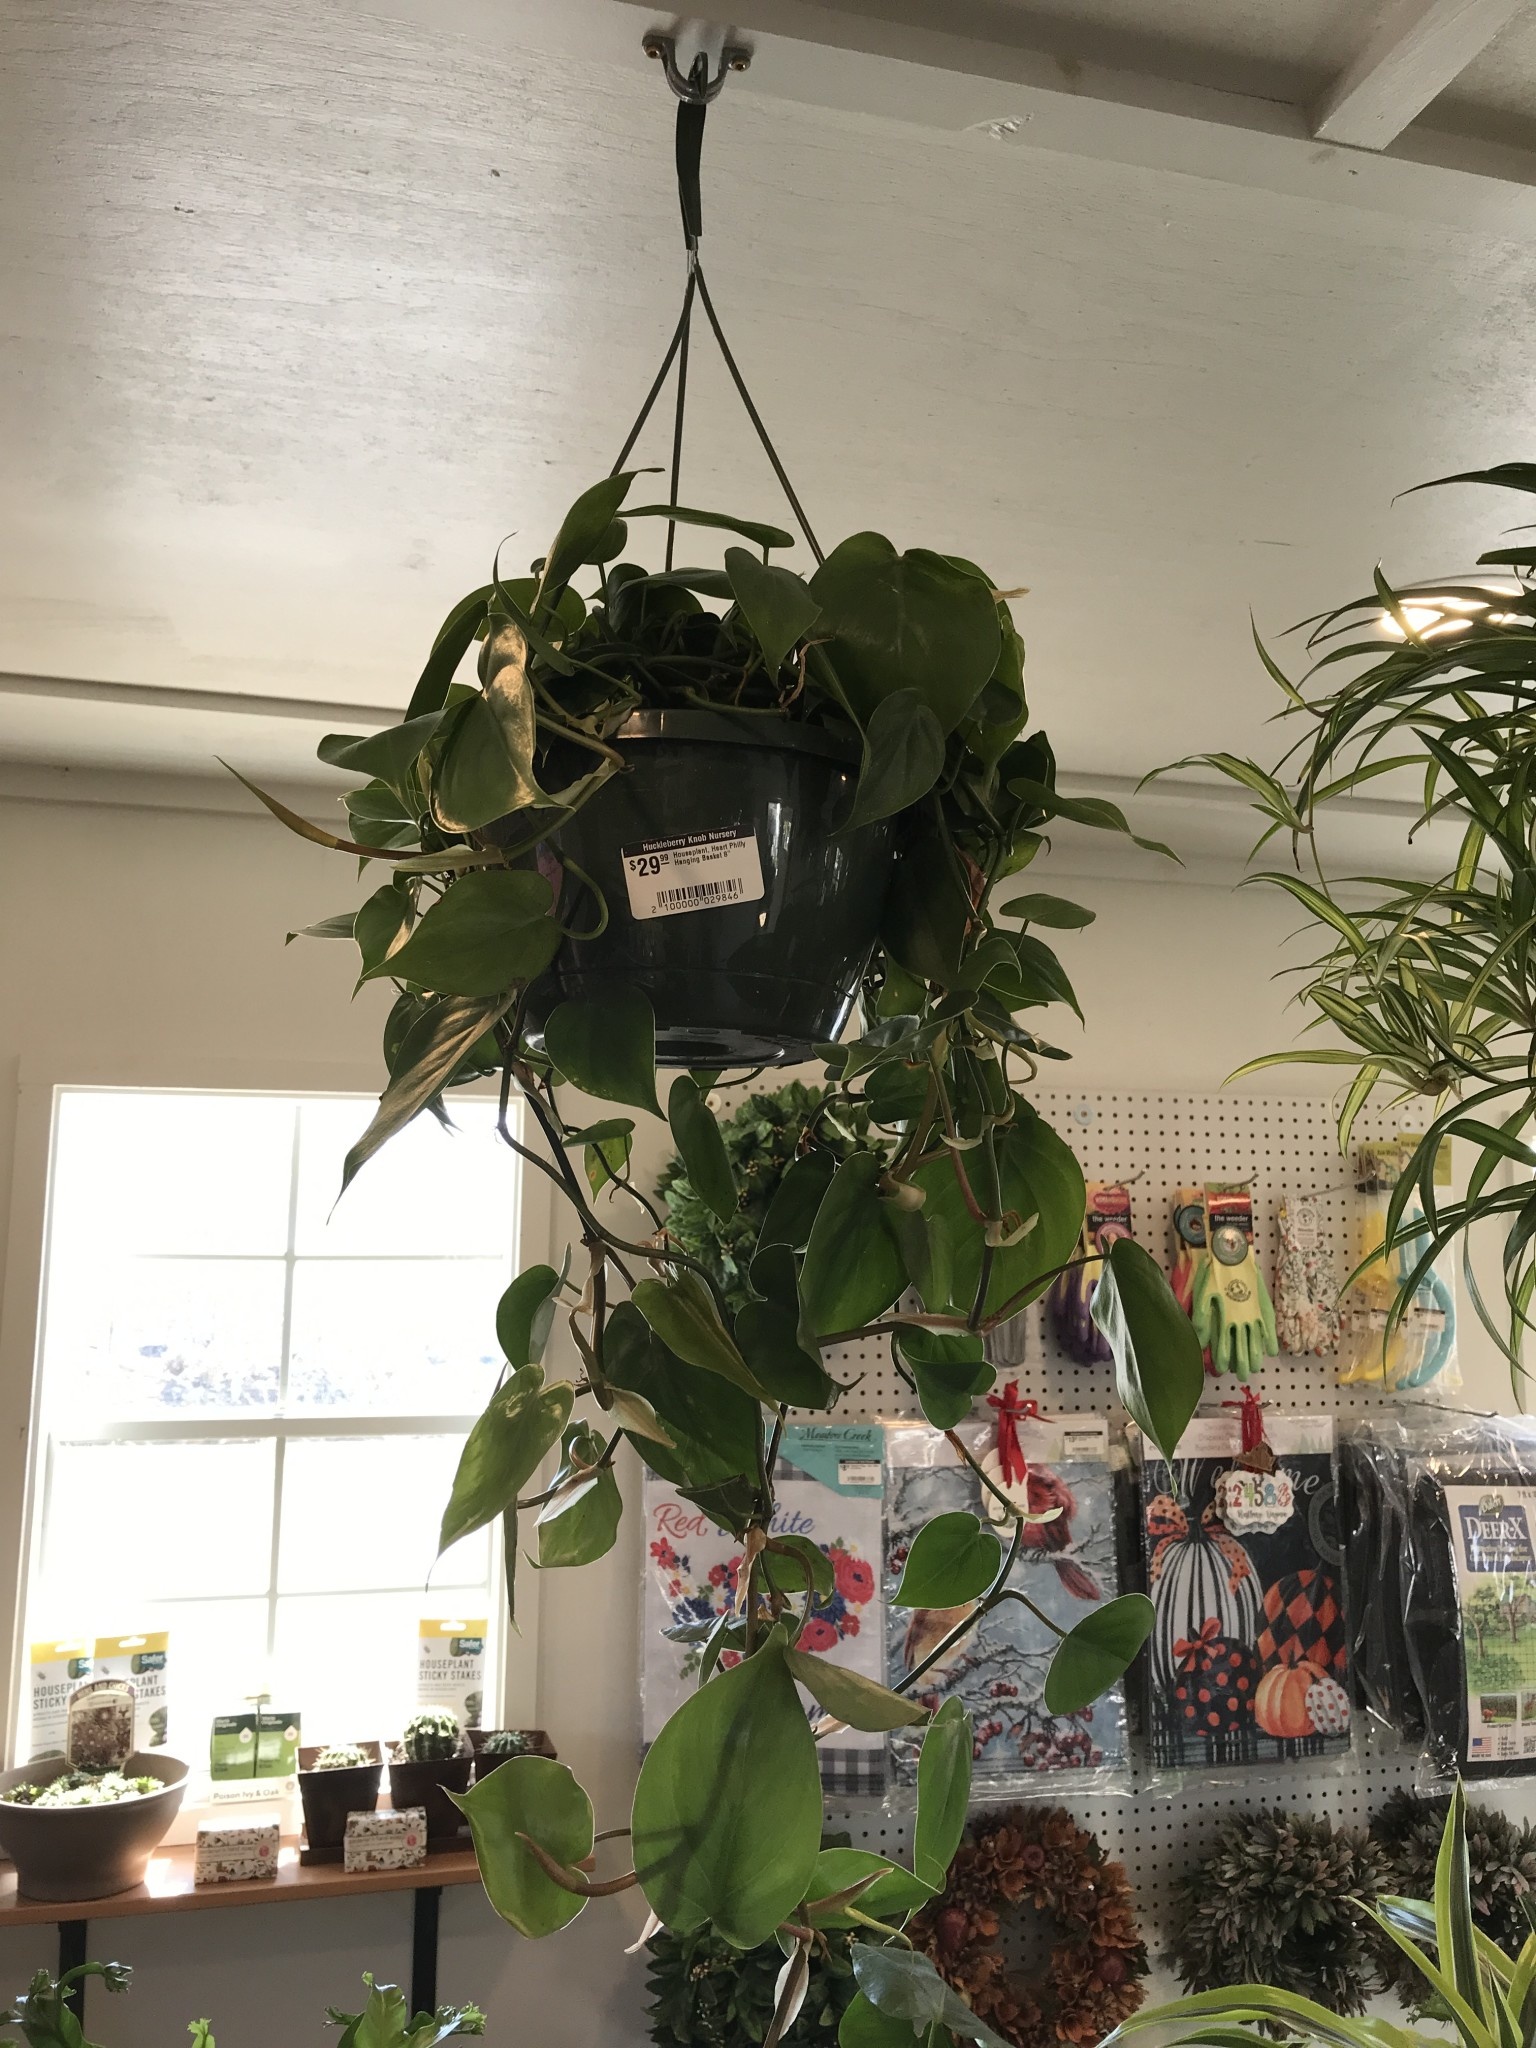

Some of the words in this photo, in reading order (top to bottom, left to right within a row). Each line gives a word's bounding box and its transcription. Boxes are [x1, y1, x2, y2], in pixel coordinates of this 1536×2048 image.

[642, 838, 686, 851] Huckleberry
[687, 833, 707, 844] Knob
[708, 829, 737, 841] Nursery
[711, 844, 728, 852] Heart
[729, 841, 746, 849] Philly
[674, 856, 700, 866] Hanging
[702, 852, 723, 862] Basket
[704, 892, 739, 905] 029846
[1214, 1214, 1225, 1222] the
[1226, 1214, 1249, 1222] weeder
[843, 1428, 873, 1441] Creek
[653, 1503, 708, 1539] Red
[769, 1502, 816, 1535] hite
[459, 1639, 481, 1650] Safer
[141, 1654, 165, 1666] Safer
[419, 1659, 474, 1669] HOUSEPLANT
[418, 1670, 448, 1680] STICKY
[450, 1670, 482, 1680] STAKES
[33, 1695, 68, 1710] STICKY
[213, 1792, 240, 1800] Poison
[255, 1789, 261, 1797] &
[262, 1788, 279, 1797] Oak
